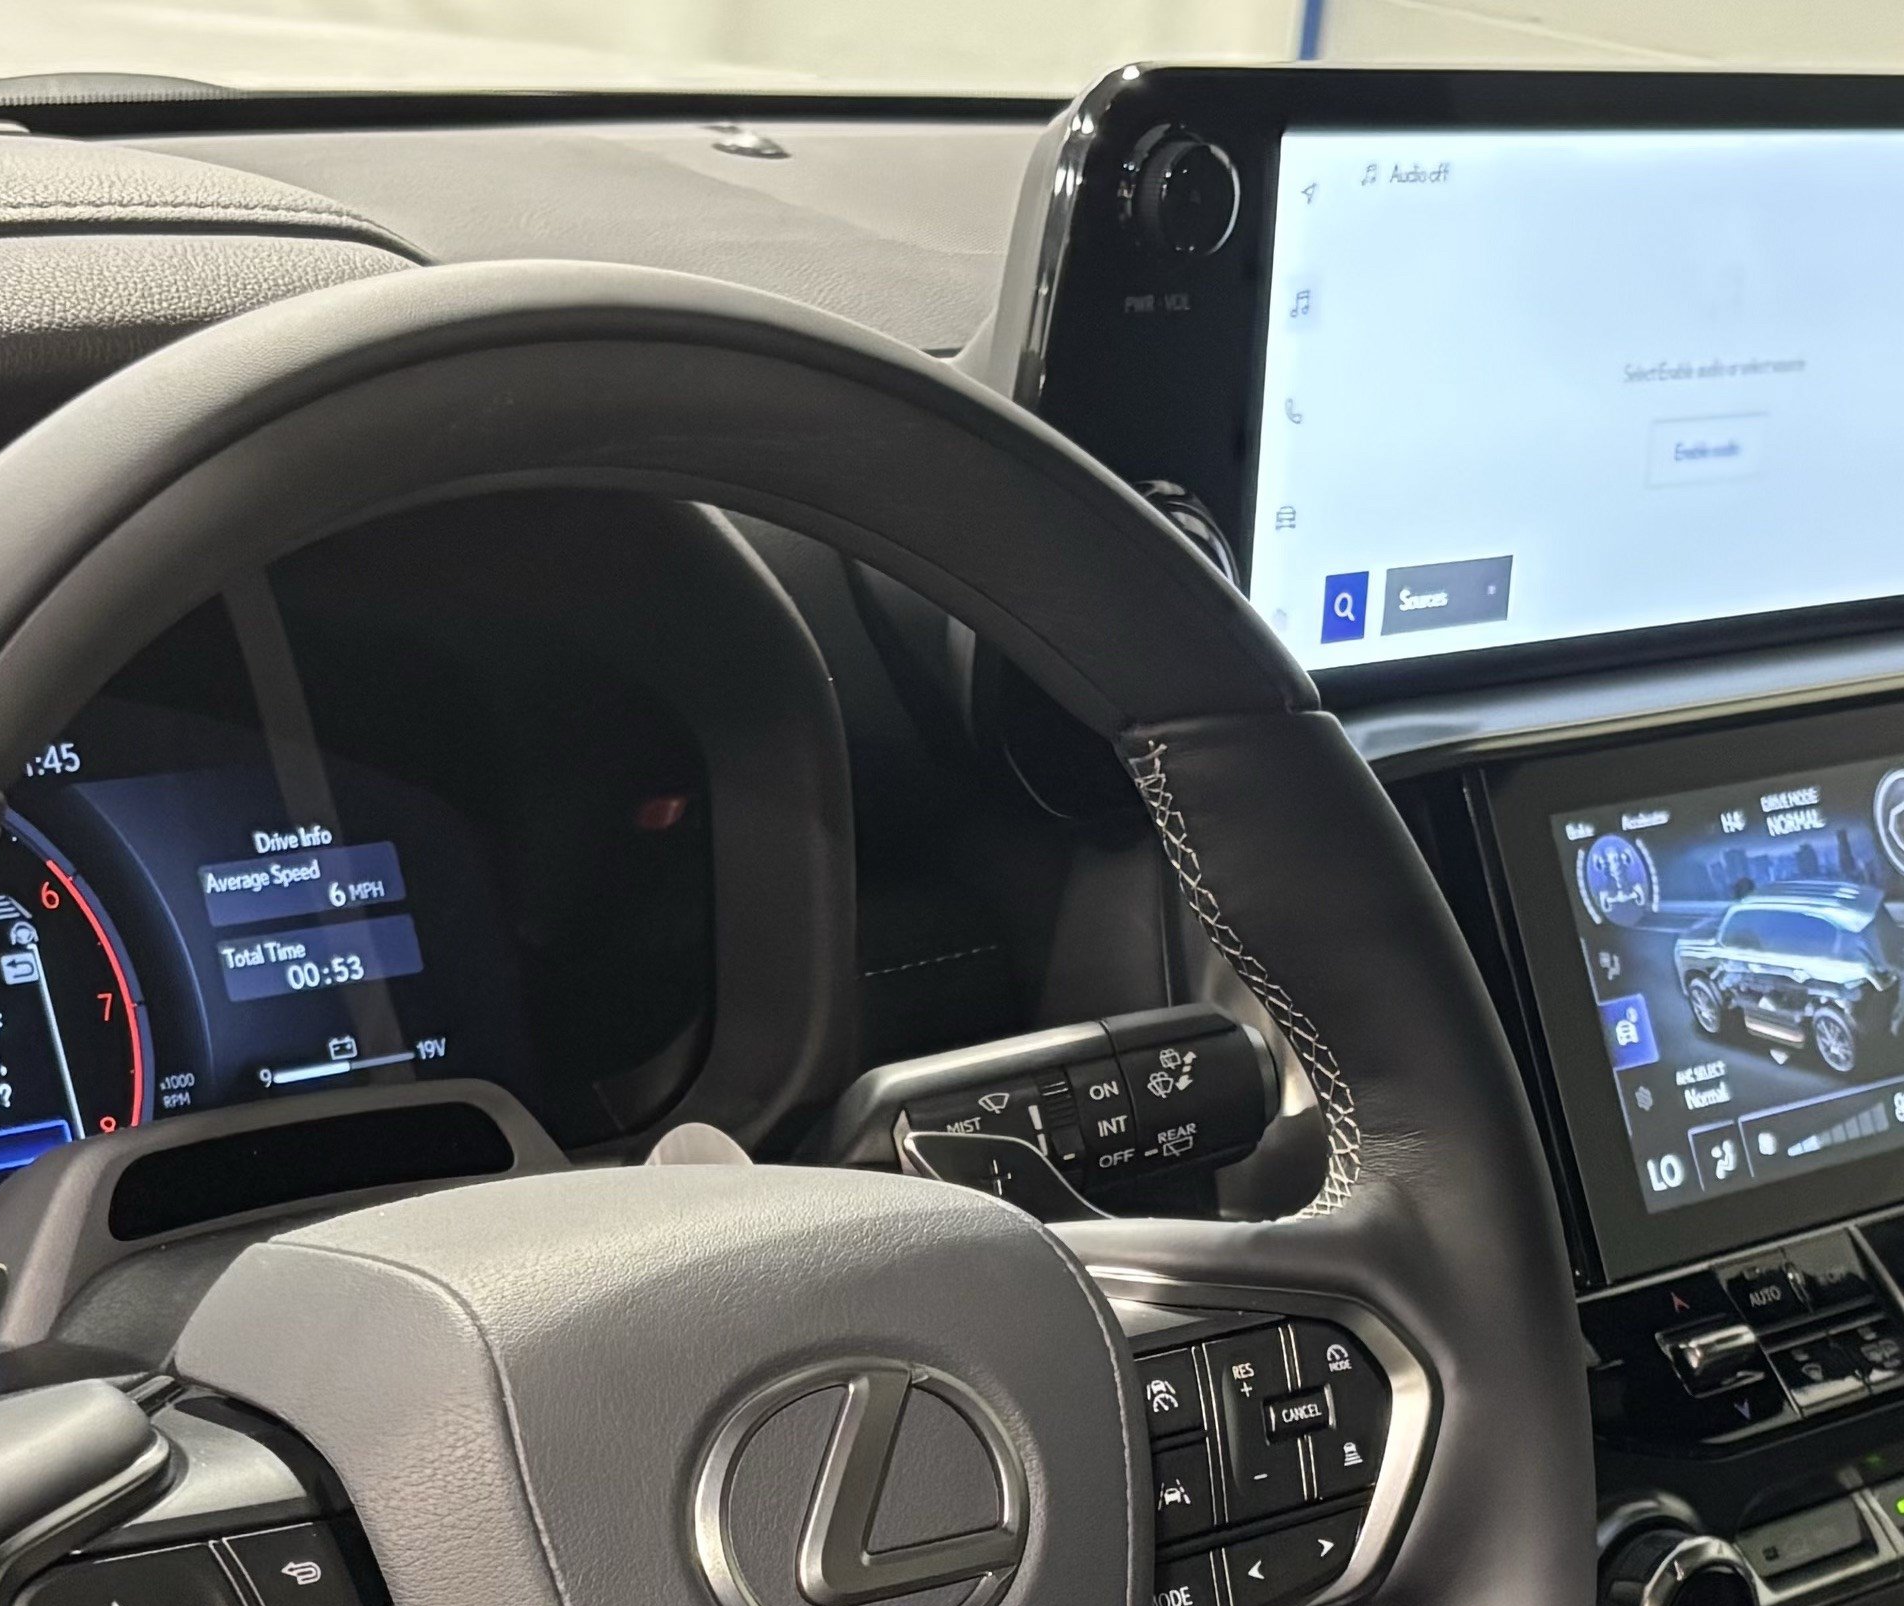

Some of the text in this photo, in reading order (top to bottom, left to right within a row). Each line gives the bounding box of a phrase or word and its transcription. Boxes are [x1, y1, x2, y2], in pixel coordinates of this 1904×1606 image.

[253, 825, 333, 854] Drive Info
[205, 859, 321, 896] Average Speed
[40, 882, 60, 910] 6
[222, 939, 307, 969] Total Time
[286, 956, 366, 993] 00:53
[97, 993, 114, 1022] 7
[1088, 1080, 1120, 1102] ON
[946, 1115, 982, 1134] MIST
[1096, 1114, 1129, 1138] INT
[1157, 1121, 1198, 1144] REAR
[1097, 1147, 1137, 1169] OFF
[1231, 1362, 1255, 1380] RES
[1281, 1402, 1322, 1424] CANCEL
